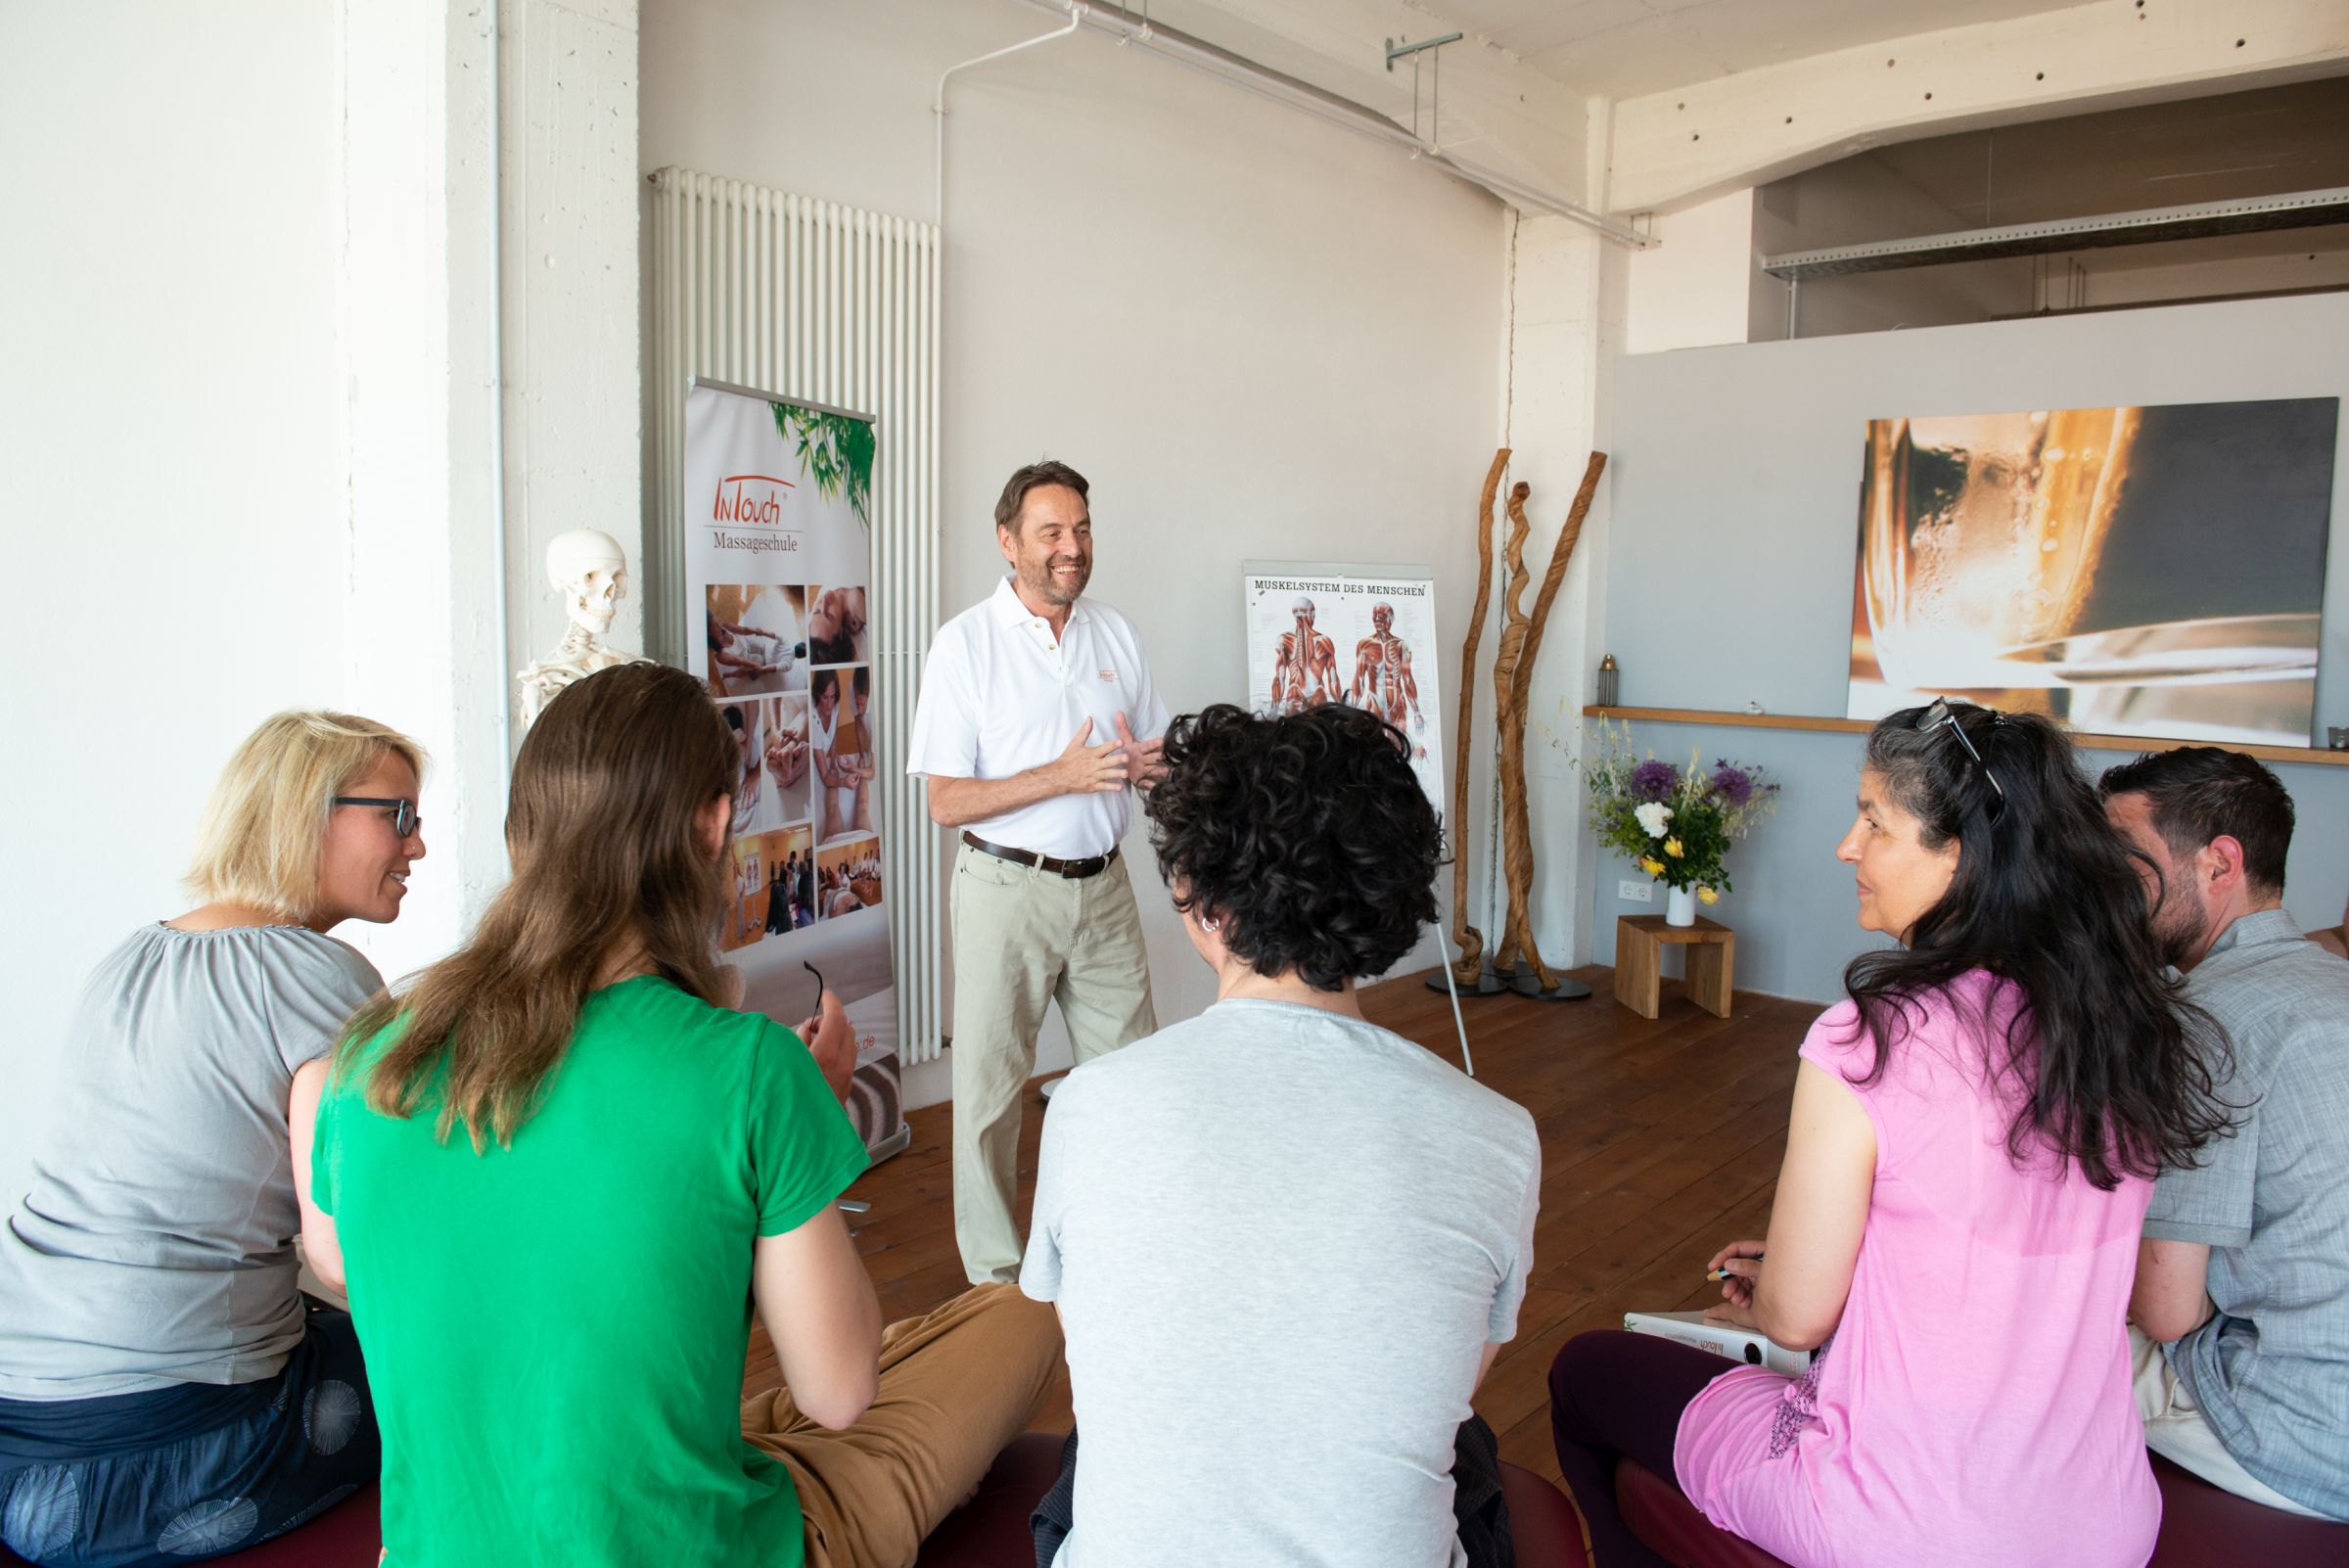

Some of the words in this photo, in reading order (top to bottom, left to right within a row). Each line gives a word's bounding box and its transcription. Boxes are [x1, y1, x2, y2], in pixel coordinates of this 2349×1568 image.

[714, 531, 798, 554] Massageschule
[1255, 579, 1340, 593] MUSKELSYSTEM
[1344, 583, 1364, 594] DES
[1367, 585, 1425, 597] MENSCHEN
